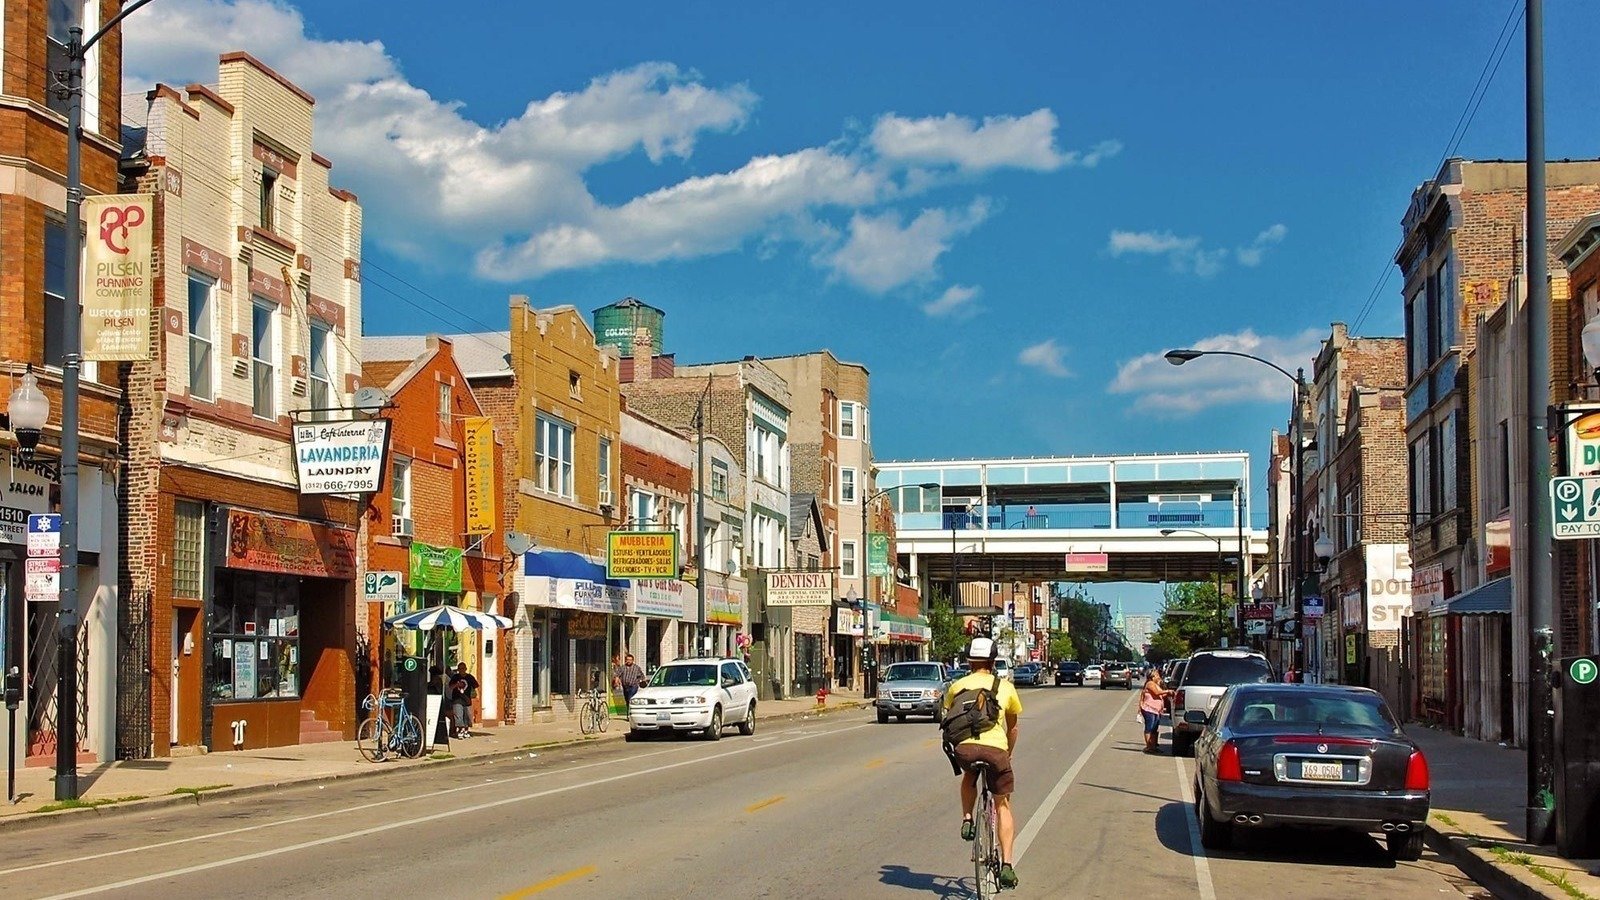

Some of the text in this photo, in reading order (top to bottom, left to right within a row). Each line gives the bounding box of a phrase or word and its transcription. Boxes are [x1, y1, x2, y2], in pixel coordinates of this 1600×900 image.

[97, 262, 143, 277] PILSEN
[96, 277, 143, 288] PLANNING
[89, 308, 147, 318] WELCOME TO
[104, 318, 134, 328] PILSEN
[300, 445, 379, 463] LAVANDERIA
[308, 466, 371, 477] LAUNDRY
[9, 482, 44, 496] SALON
[305, 480, 373, 491] (312) 666-7995
[1563, 484, 1575, 498] P
[0, 507, 24, 522] 1510
[1561, 523, 1600, 533] PAY TO
[620, 536, 665, 547] MUEBLERIA
[772, 574, 826, 588] DENTISTA
[1579, 663, 1591, 680] P
